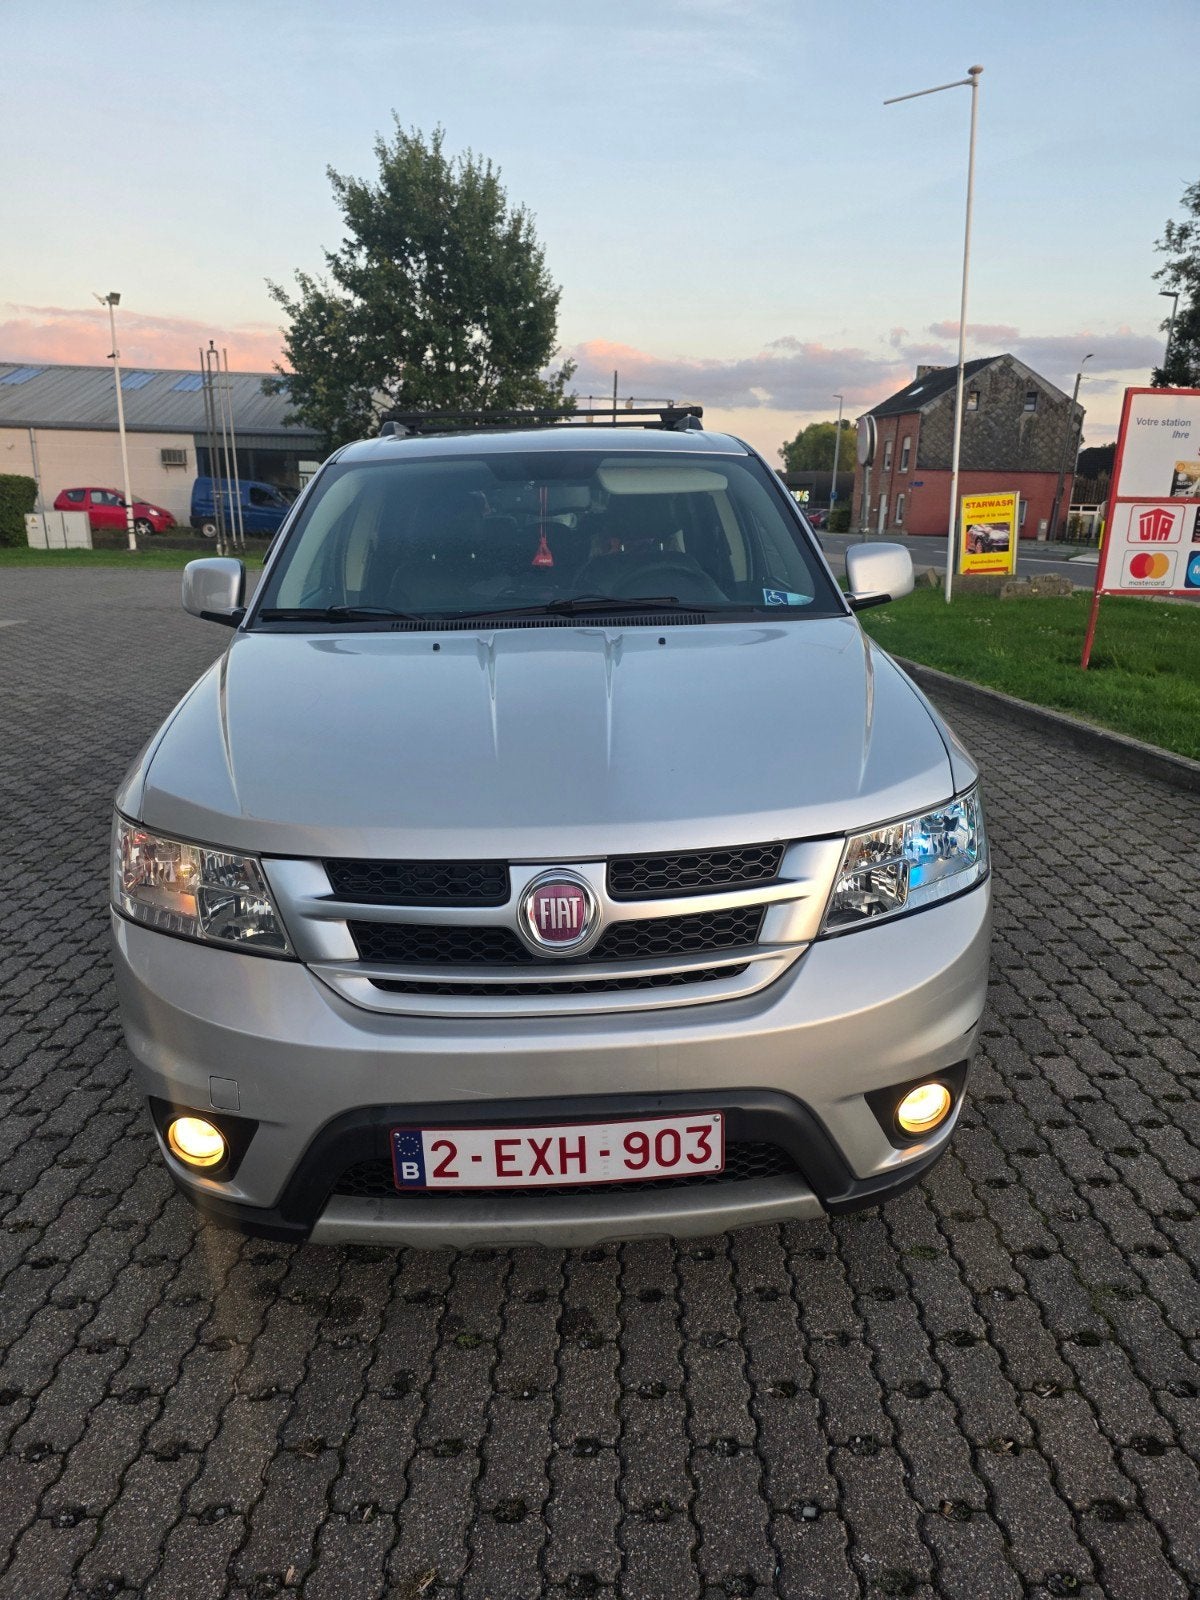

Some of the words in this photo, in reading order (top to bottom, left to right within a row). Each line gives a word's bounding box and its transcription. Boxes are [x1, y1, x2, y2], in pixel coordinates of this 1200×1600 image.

[1136, 417, 1159, 426] Votre
[1161, 418, 1191, 427] station
[1172, 430, 1190, 439] Ihre
[1139, 508, 1176, 541] UTA
[540, 897, 581, 930] FIAT
[430, 1125, 712, 1178] 2-EXH-903
[402, 1161, 420, 1180] B
